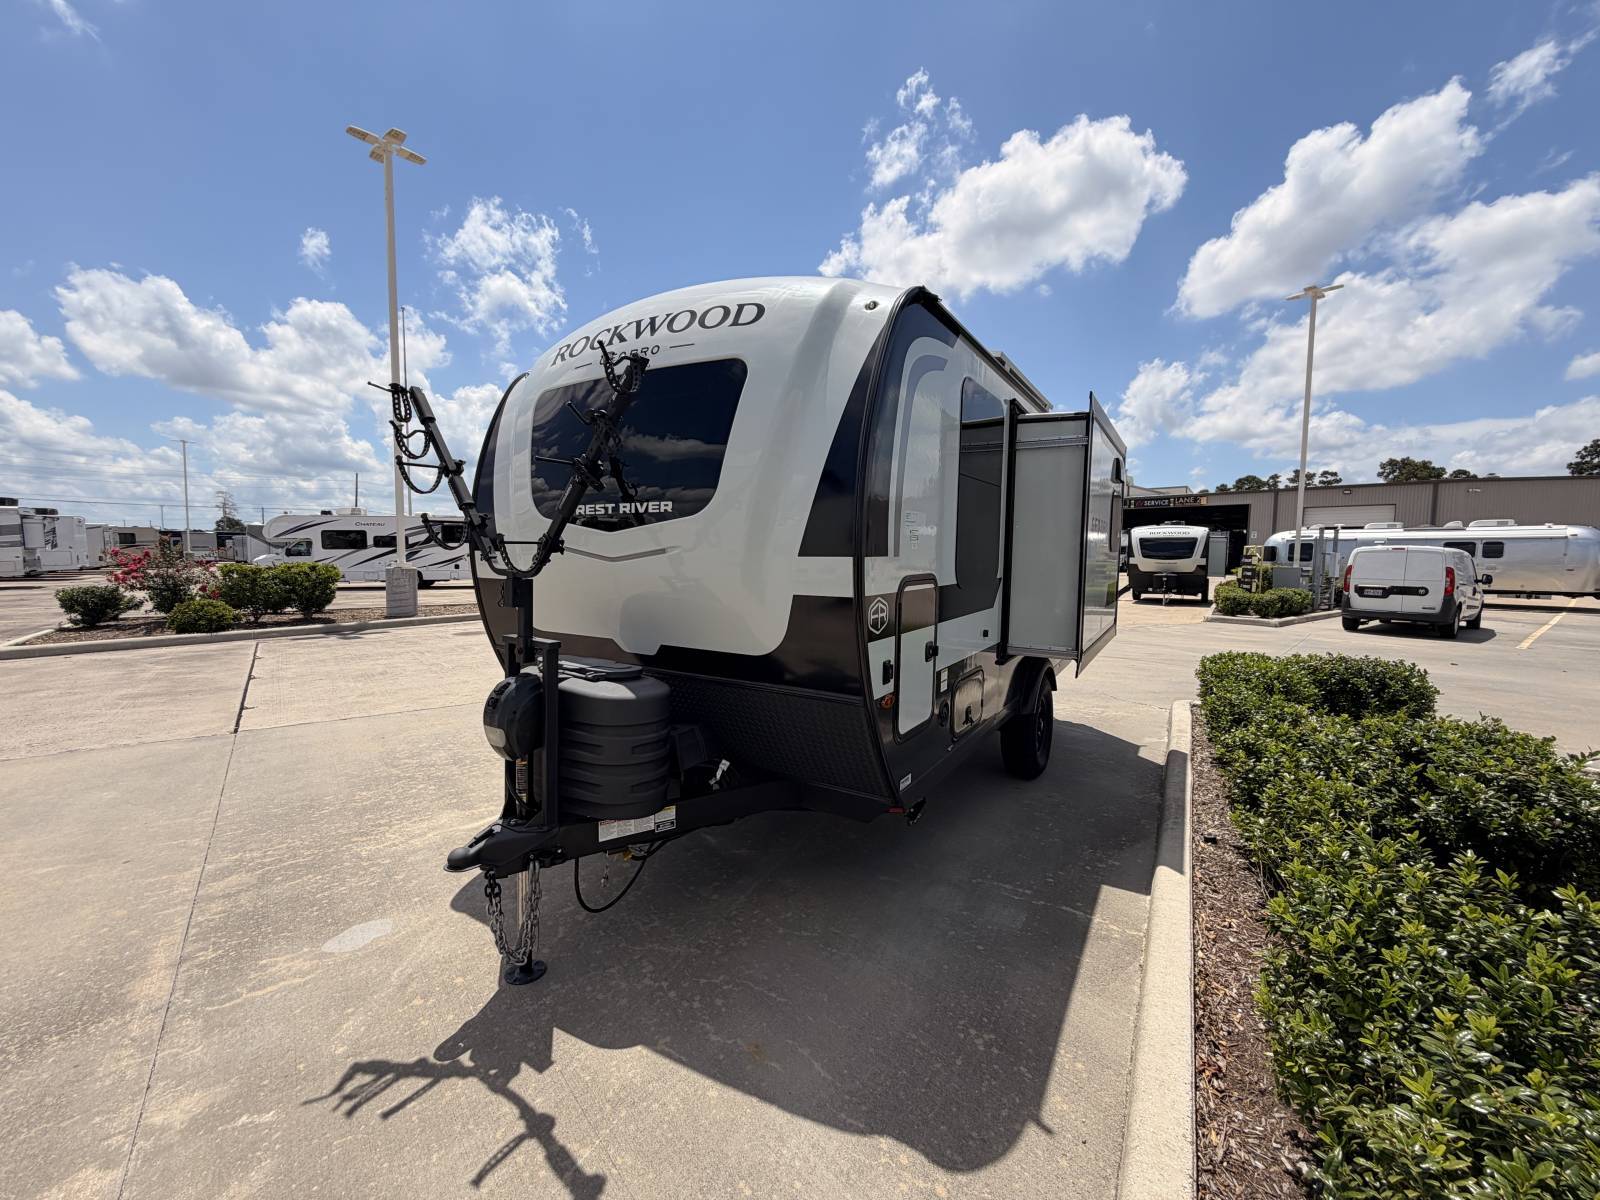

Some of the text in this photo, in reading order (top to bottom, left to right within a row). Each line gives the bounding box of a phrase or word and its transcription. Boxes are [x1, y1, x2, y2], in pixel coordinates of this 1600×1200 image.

[551, 302, 766, 367] ROCKWOOD
[576, 501, 673, 515] REST RIVER
